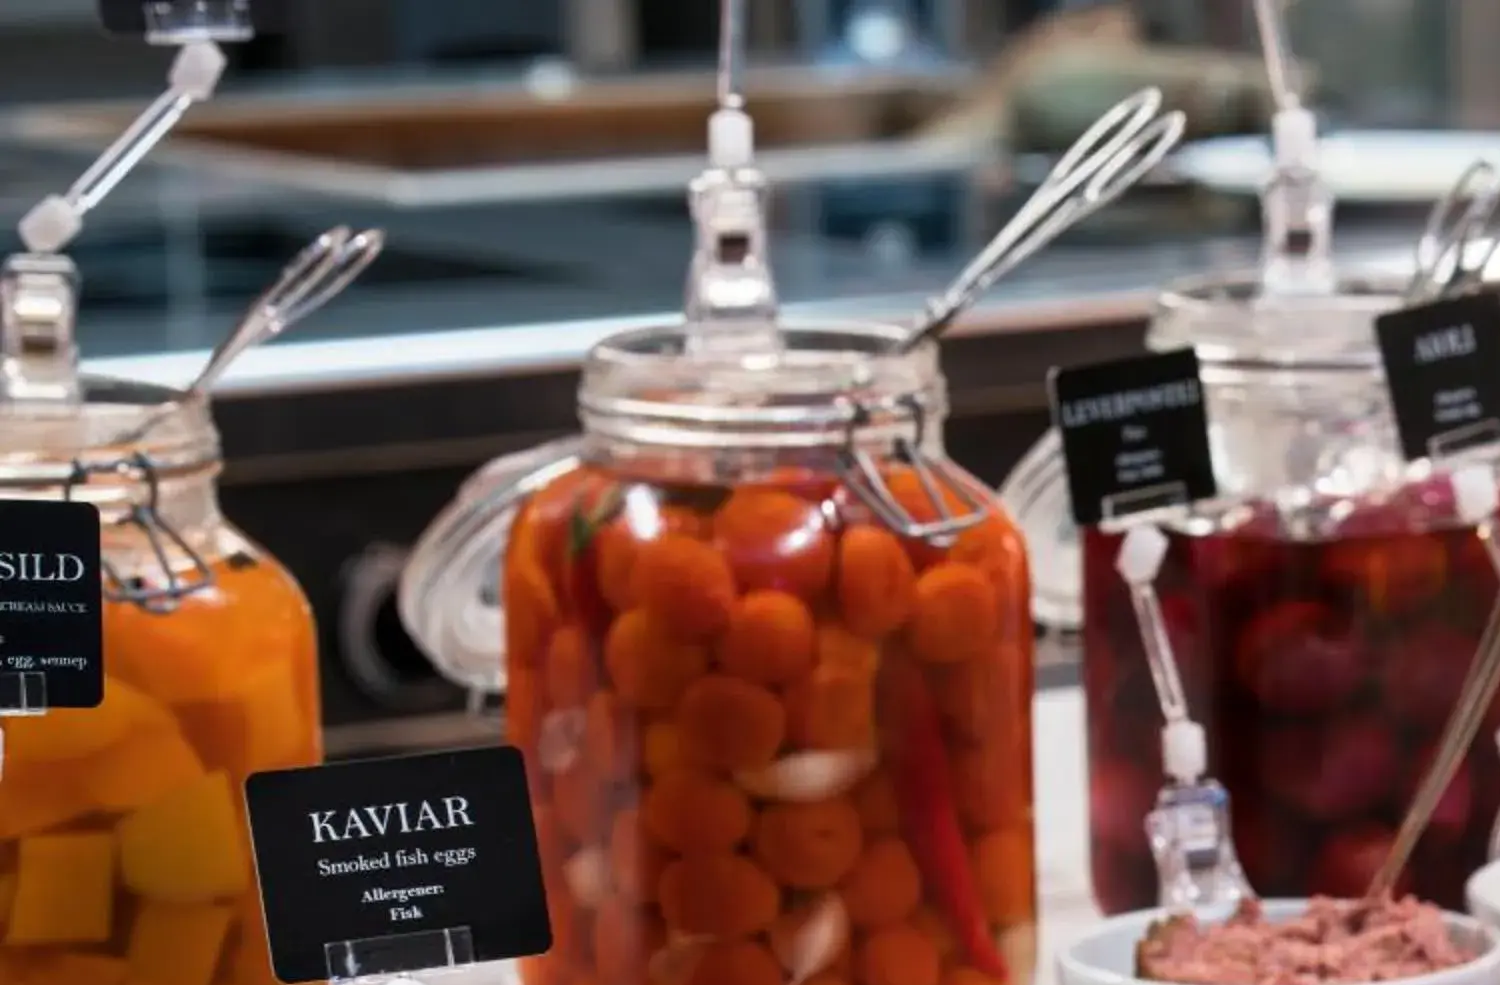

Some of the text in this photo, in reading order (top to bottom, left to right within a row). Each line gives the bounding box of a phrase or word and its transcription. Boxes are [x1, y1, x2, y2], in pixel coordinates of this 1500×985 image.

[308, 795, 475, 843] KAVIAR
[317, 847, 477, 877] Smoked fish eggs
[361, 884, 445, 903] Allergener:
[390, 905, 424, 922] Fisk
